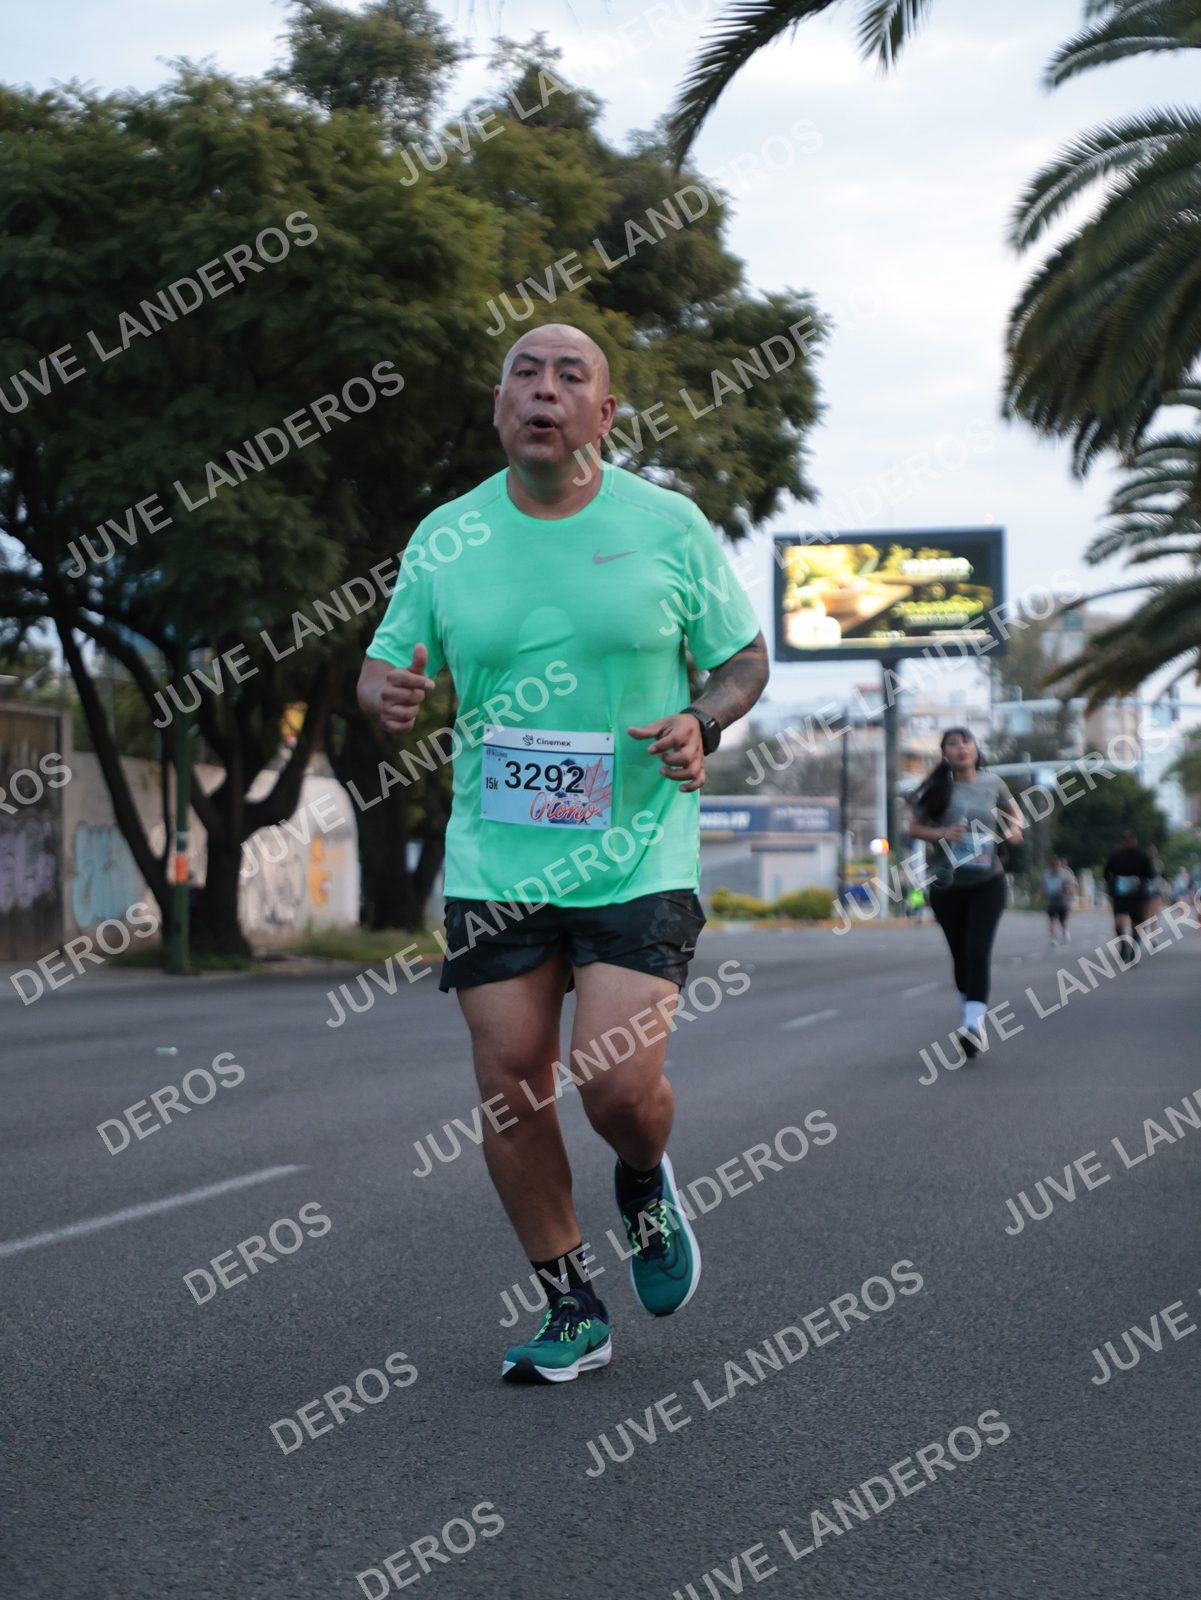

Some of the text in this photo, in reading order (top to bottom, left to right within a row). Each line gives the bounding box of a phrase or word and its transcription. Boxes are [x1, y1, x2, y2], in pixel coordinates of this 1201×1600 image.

[536, 737, 571, 747] Cinemex
[485, 776, 499, 790] 15k
[504, 760, 585, 794] 3292
